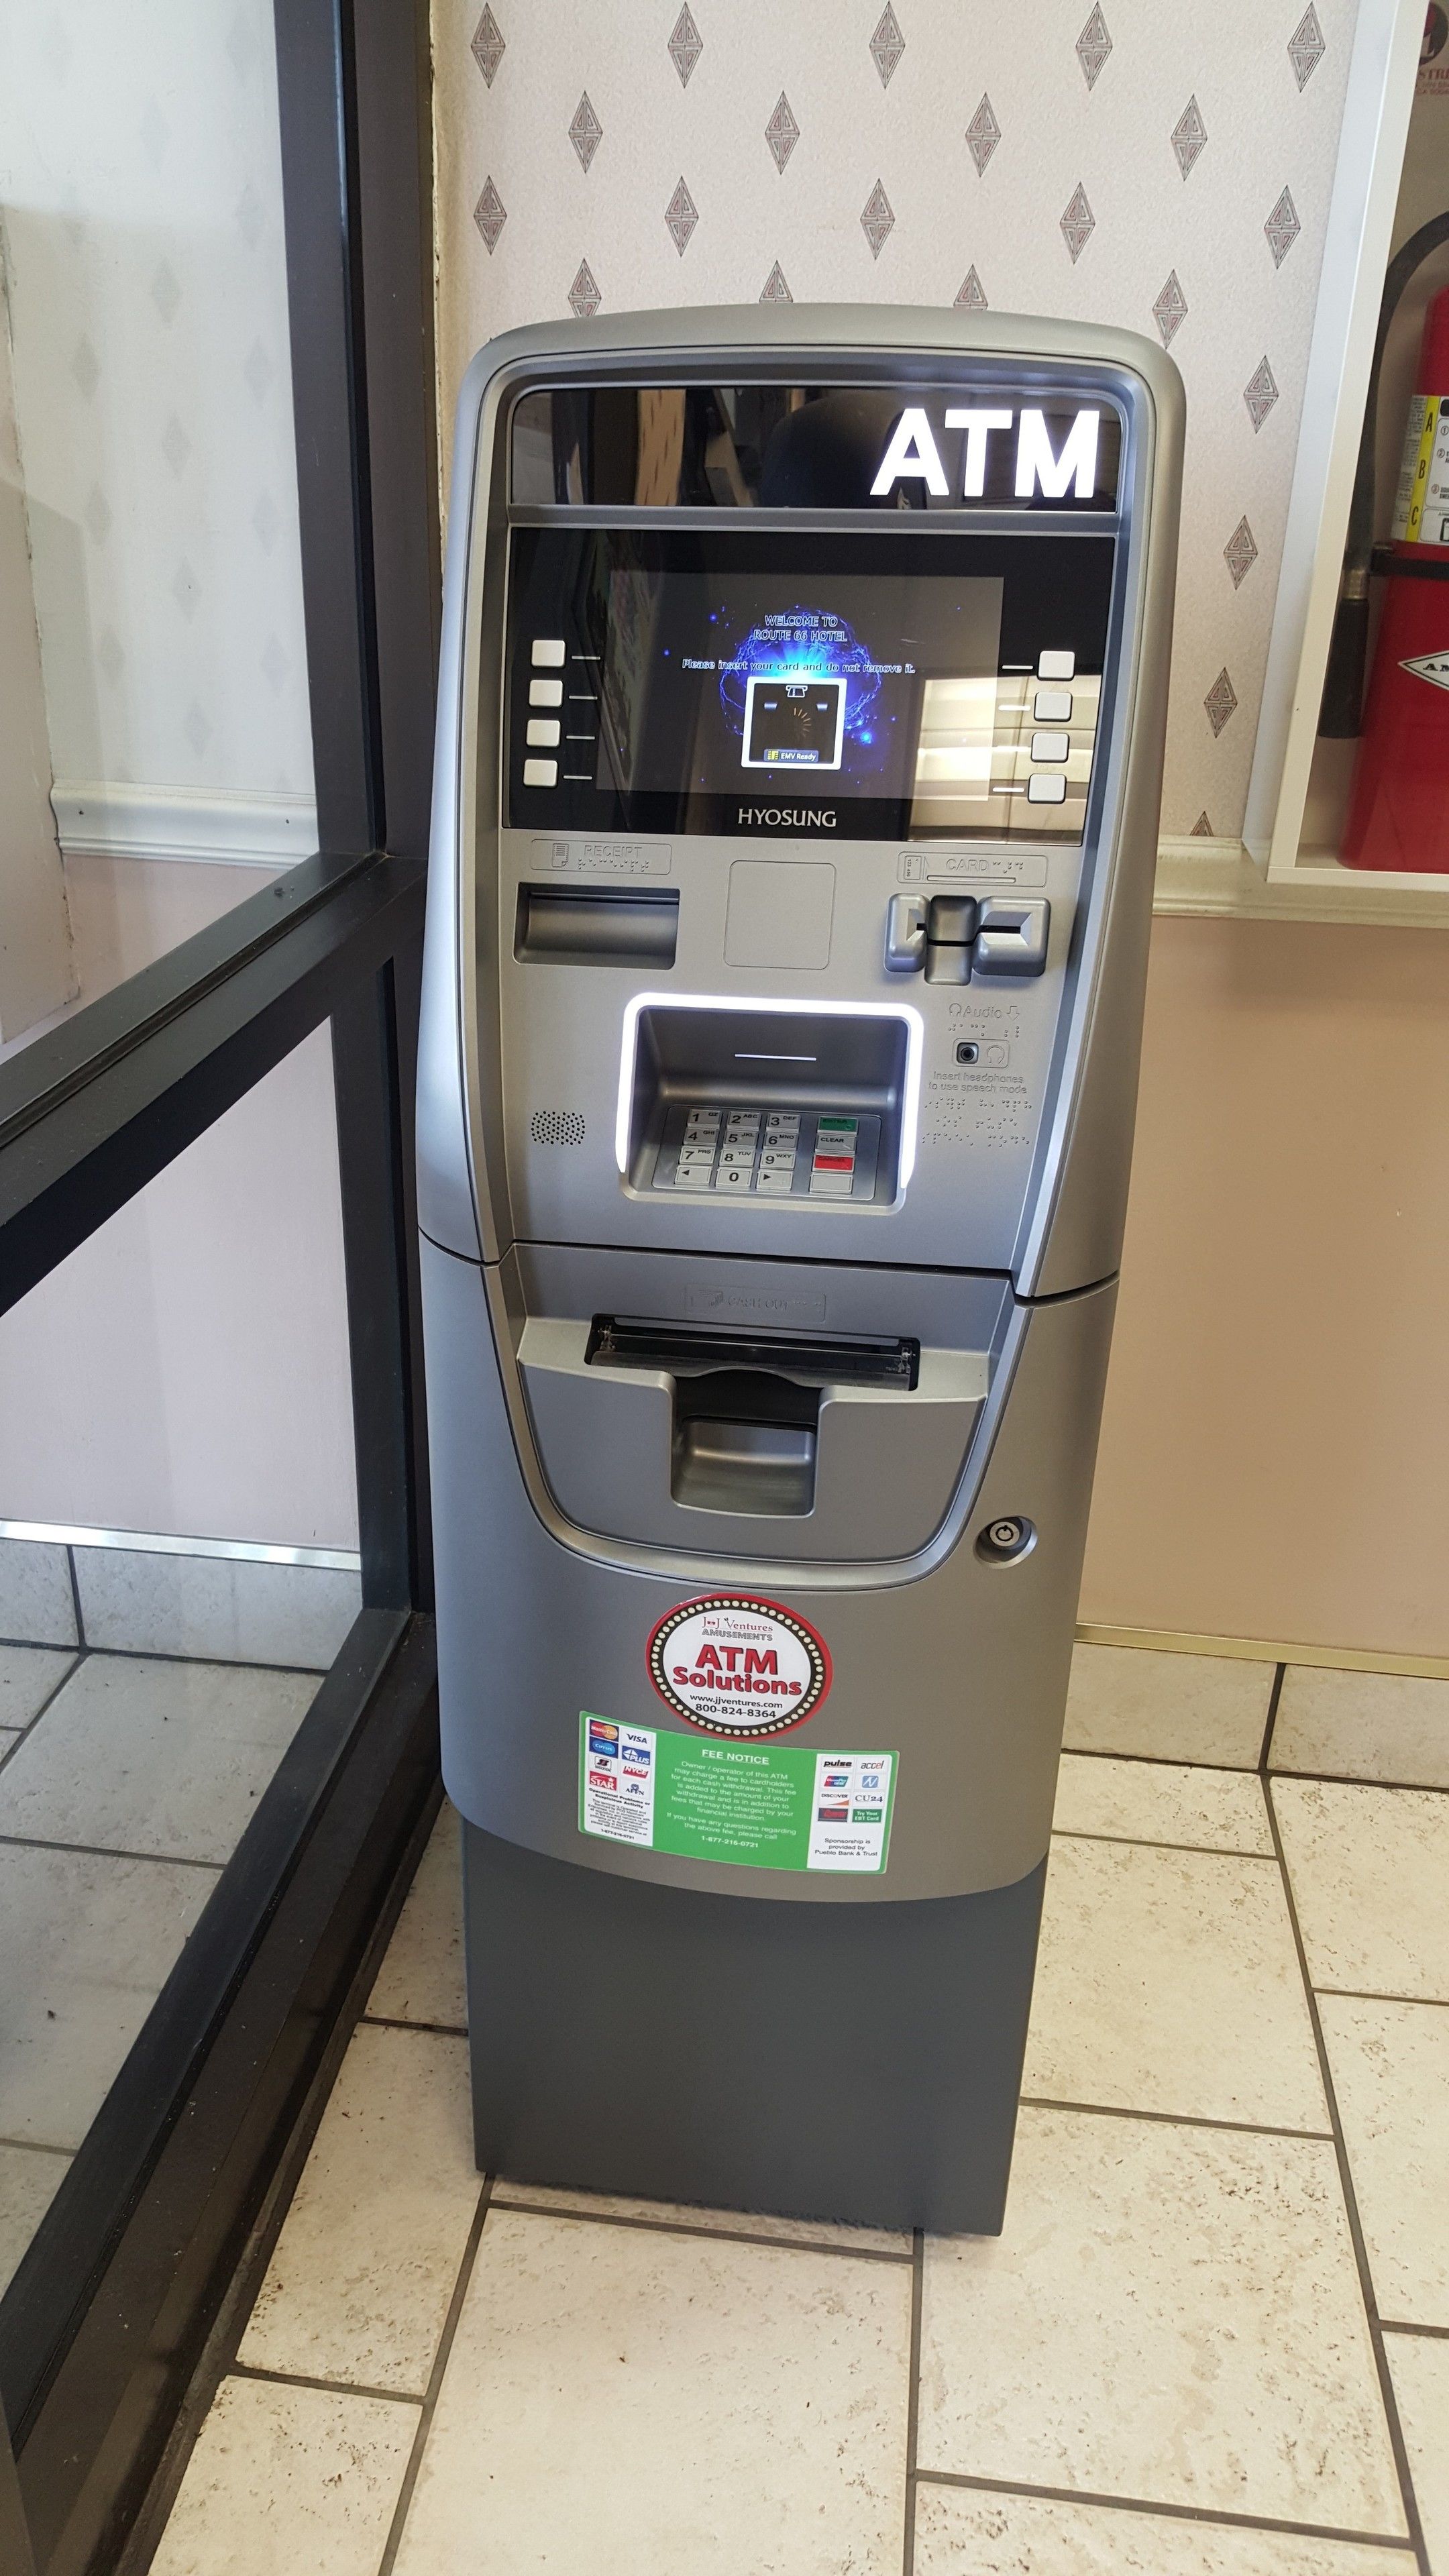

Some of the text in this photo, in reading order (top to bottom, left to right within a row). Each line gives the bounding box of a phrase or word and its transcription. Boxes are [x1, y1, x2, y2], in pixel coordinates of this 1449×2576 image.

[1426, 412, 1433, 432] A
[869, 408, 1100, 498] ATM
[1418, 460, 1426, 479] B
[1411, 506, 1419, 525] C
[765, 614, 838, 627] WELCOME TO
[754, 629, 847, 642] ROUTE 66 HOTEL
[682, 659, 916, 674] Please insert your card and do not remove it.
[796, 753, 816, 761] Ready
[738, 808, 837, 827] HYOSUNG
[584, 845, 643, 858] RECEIPT
[946, 859, 989, 872] CARD
[963, 1006, 1004, 1018] Audio
[934, 1071, 1024, 1083] Insert headphones
[929, 1081, 938, 1089] to
[961, 1083, 997, 1093] speech
[1000, 1085, 1027, 1094] mode
[692, 1113, 700, 1122] 1
[731, 1115, 741, 1124] 2
[771, 1117, 780, 1126] 3
[688, 1132, 698, 1140] 4
[728, 1134, 738, 1143] 5
[768, 1136, 777, 1145] 6
[685, 1151, 694, 1160] 7
[724, 1153, 734, 1162] 8
[765, 1155, 775, 1164] 9
[729, 1172, 739, 1182] 0
[724, 1617, 773, 1631] Ventures
[702, 1628, 773, 1642] AMUSEMENTS
[694, 1644, 778, 1675] ATM
[673, 1666, 802, 1696] Solutions
[690, 1694, 783, 1709] www.jjventures.com
[695, 1703, 777, 1719] 800-824-8364
[627, 1733, 647, 1744] VISA
[629, 1755, 650, 1764] PLUS
[702, 1749, 769, 1765] FEE NOTICE
[682, 1761, 706, 1770] Owner
[712, 1767, 744, 1776] operator
[823, 1759, 852, 1768] pulse
[861, 1760, 884, 1769] accel
[625, 1766, 647, 1776] NYCE
[590, 1777, 614, 1790] STAR
[674, 1768, 690, 1776] may
[692, 1770, 718, 1780] charge
[749, 1779, 794, 1788] cardholders
[685, 1784, 708, 1792] added
[589, 1788, 618, 1798] Operational
[619, 1796, 643, 1804] Problems
[595, 1794, 623, 1803] Suspicious
[676, 1790, 715, 1801] withdrawal
[672, 1795, 687, 1803] fees
[734, 1805, 764, 1814] charged
[697, 1807, 727, 1816] financial
[723, 1823, 759, 1831] questions
[761, 1827, 796, 1835] regarding
